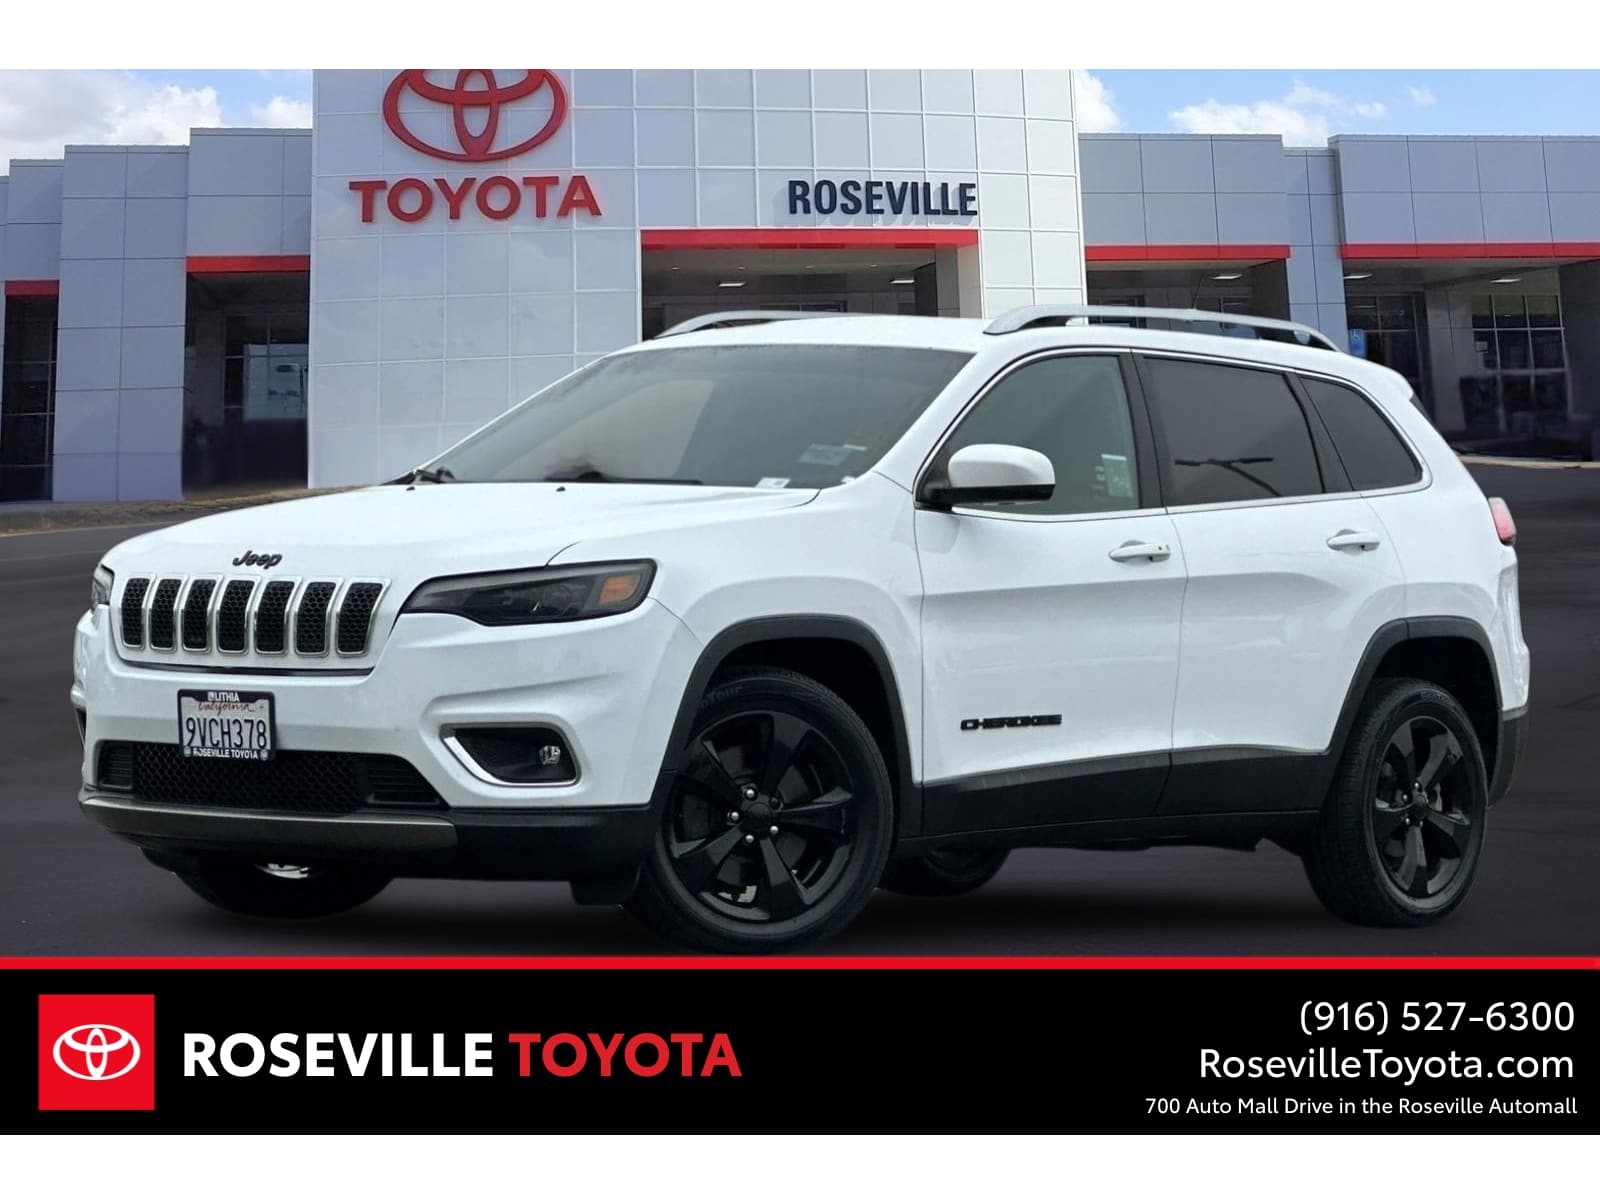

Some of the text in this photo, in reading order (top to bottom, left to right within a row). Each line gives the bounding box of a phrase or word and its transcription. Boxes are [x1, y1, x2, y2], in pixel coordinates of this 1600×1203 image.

[349, 175, 602, 223] TOYOTA
[788, 179, 979, 217] ROSEVILLE
[232, 550, 283, 570] Jeep
[214, 691, 241, 702] LITHIA
[960, 714, 1063, 731] CHEROKEE
[185, 716, 268, 750] 9VCH378
[192, 747, 259, 760] ROSEVILLE TOYOTA
